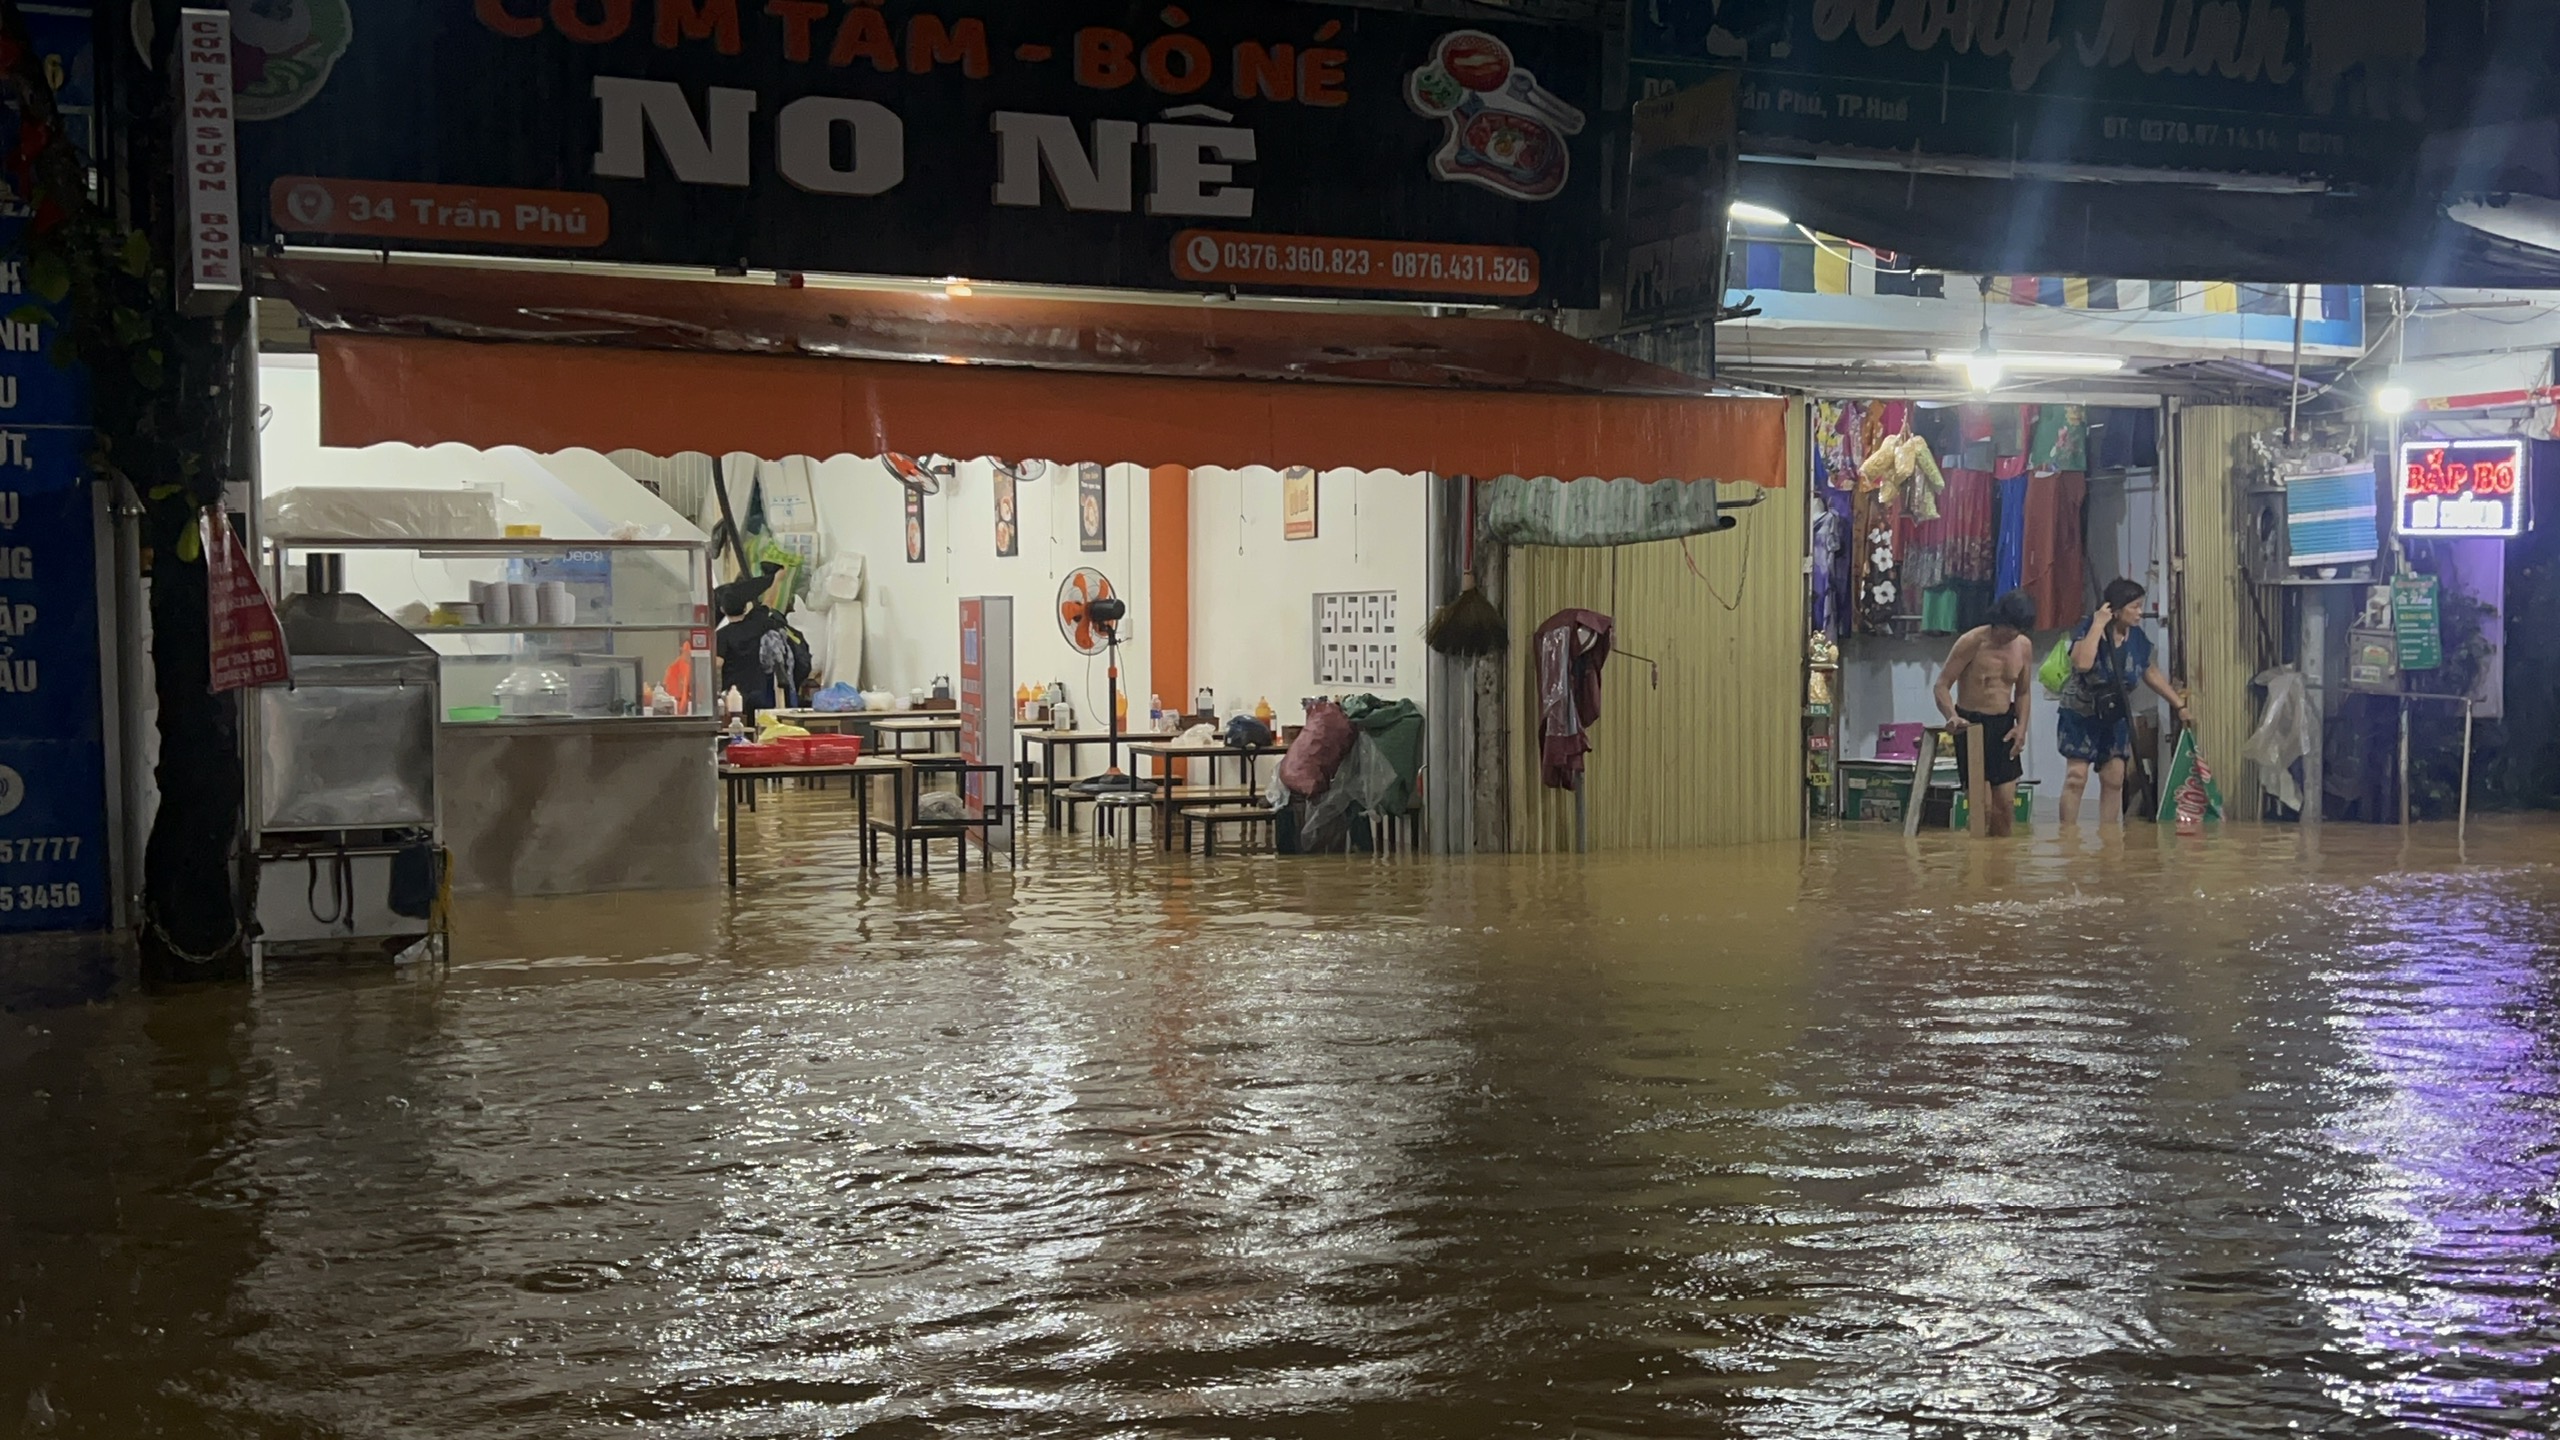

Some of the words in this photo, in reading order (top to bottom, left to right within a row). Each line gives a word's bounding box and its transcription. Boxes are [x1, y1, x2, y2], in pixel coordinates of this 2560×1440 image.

[1073, 5, 1213, 94] BÒ
[1233, 19, 1350, 107] NÉ
[591, 75, 905, 197] NO
[990, 104, 1257, 218] NÊ
[347, 195, 396, 223] 34
[515, 204, 588, 235] Phú
[1223, 241, 1371, 276] 0376.360.823
[1392, 251, 1530, 284] 0876.431.526
